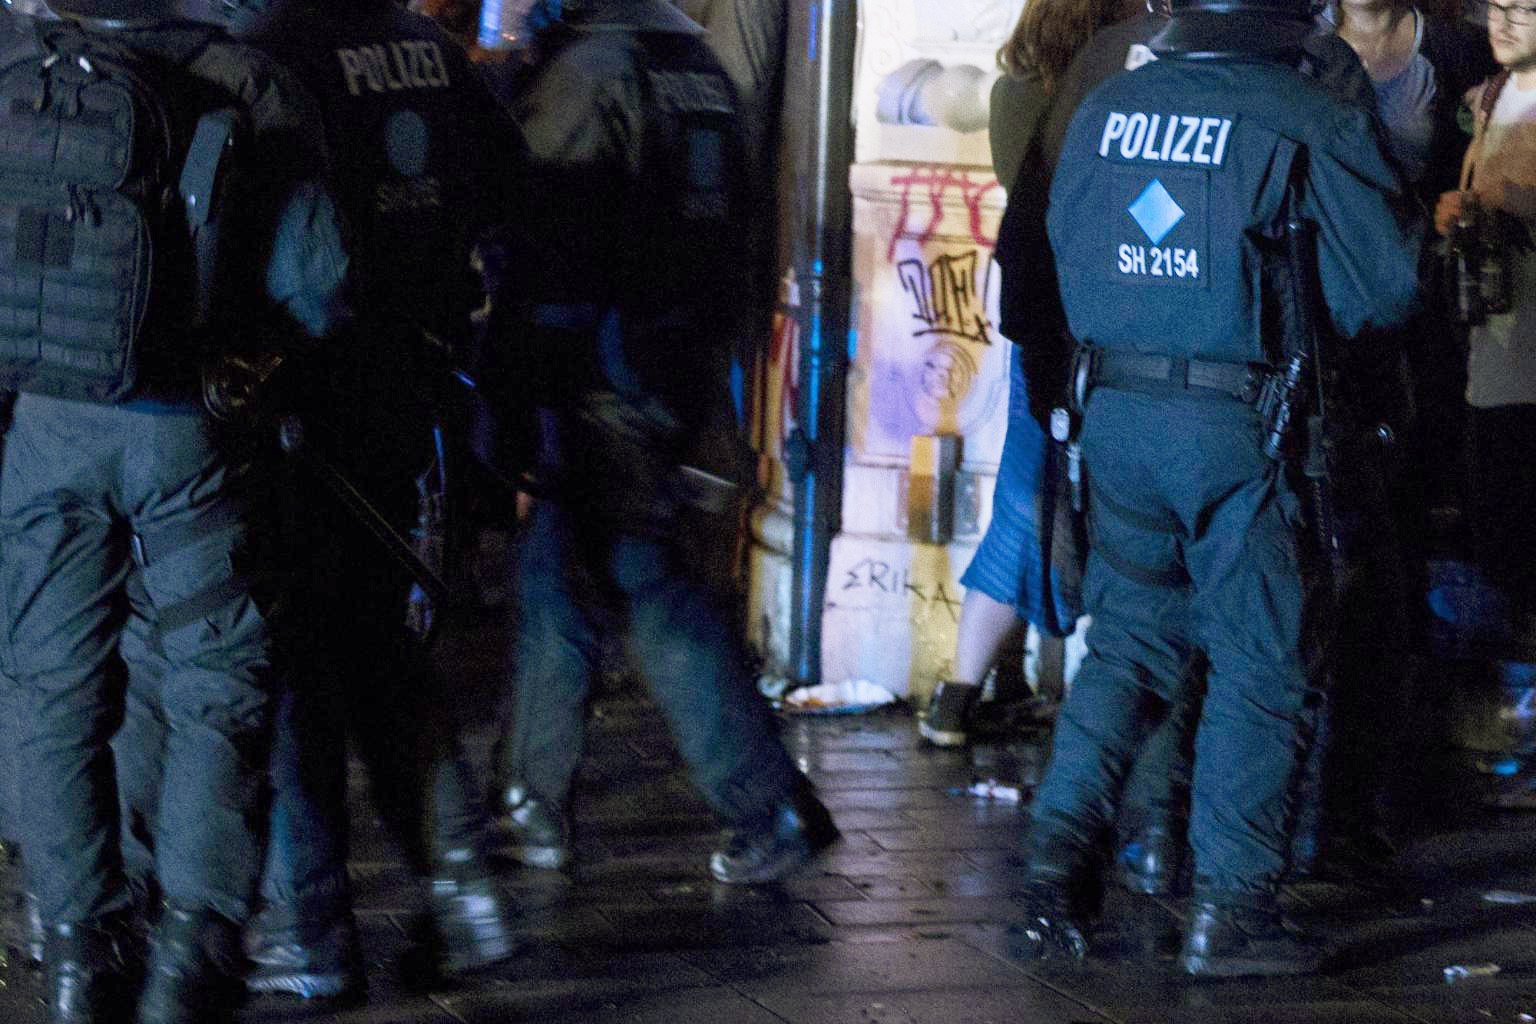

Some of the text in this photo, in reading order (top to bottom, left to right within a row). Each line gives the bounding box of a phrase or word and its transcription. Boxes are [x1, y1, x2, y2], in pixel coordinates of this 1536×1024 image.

[336, 40, 450, 96] POLIZEI
[1098, 110, 1233, 166] POLIZEI
[1117, 242, 1200, 280] SH 2154
